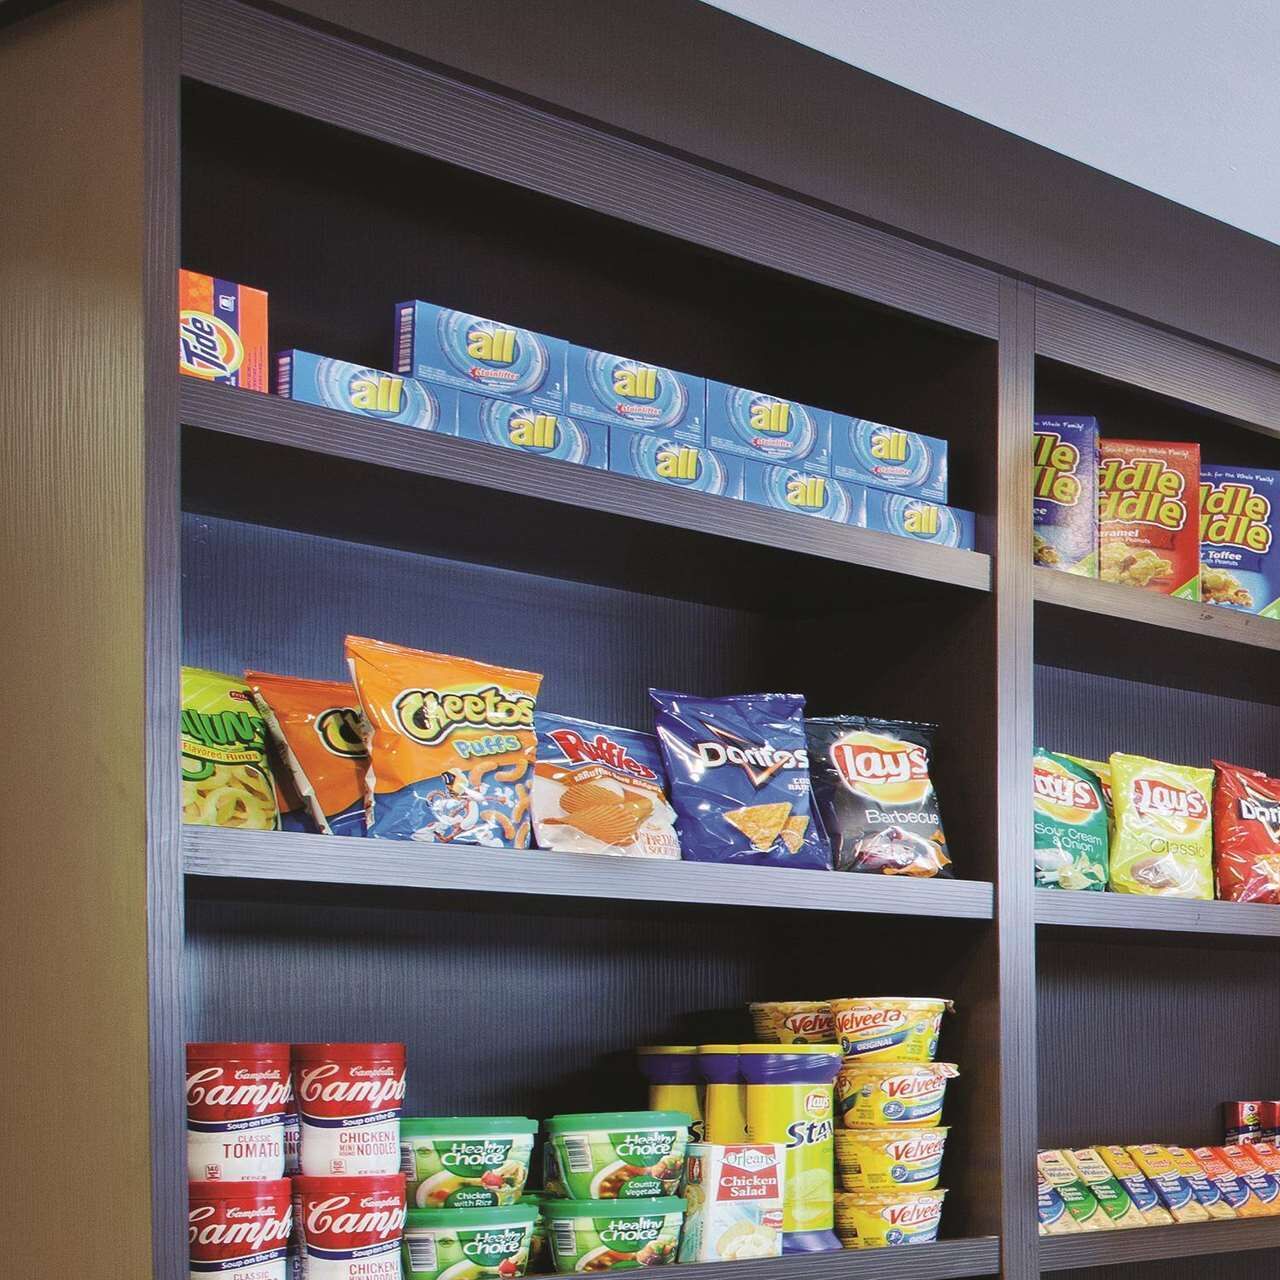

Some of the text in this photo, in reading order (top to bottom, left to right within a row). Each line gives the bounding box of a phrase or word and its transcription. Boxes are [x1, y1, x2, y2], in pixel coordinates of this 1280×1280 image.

[180, 316, 228, 374] Tide
[467, 328, 517, 363] all
[613, 367, 658, 400] all
[350, 377, 404, 413] all
[750, 402, 791, 433] all
[510, 414, 557, 448] all
[871, 432, 908, 461] all
[656, 448, 701, 480] all
[1100, 460, 1183, 495] ddle
[785, 477, 826, 508] all
[904, 506, 938, 534] all
[1100, 491, 1185, 527] ddle
[396, 686, 536, 743] Cheetos
[453, 736, 522, 759] Puffs
[547, 729, 658, 781] Ruffles
[698, 741, 808, 771] Doritos
[845, 745, 930, 784] Lay's
[1034, 775, 1098, 809] ay's
[865, 809, 938, 826] Barbecue
[1034, 824, 1102, 846] Sour Cream
[1061, 838, 1094, 852] Onion
[1150, 839, 1206, 858] Classic
[791, 1010, 833, 1034] Velve
[836, 1008, 902, 1032] Velveeta
[339, 1131, 391, 1144] CHICKEN
[452, 1140, 512, 1156] Healthy
[615, 1141, 672, 1156] Choice
[624, 1131, 676, 1147] Healthy
[223, 1143, 281, 1160] TOMATO
[357, 1143, 397, 1157] NOODLES
[441, 1151, 507, 1167] Choice
[725, 1150, 777, 1165] Orleans
[895, 1140, 944, 1161] Velvee
[629, 1181, 660, 1190] Country
[720, 1176, 777, 1187] Chicken
[730, 1185, 767, 1196] Salad
[454, 1199, 493, 1208] with Rice
[456, 1191, 492, 1200] Chicken
[608, 1217, 664, 1233] Healthy
[890, 1203, 942, 1225] Velvee
[475, 1229, 526, 1245] Healthy
[599, 1227, 659, 1243] Choice
[463, 1238, 521, 1256] Choice
